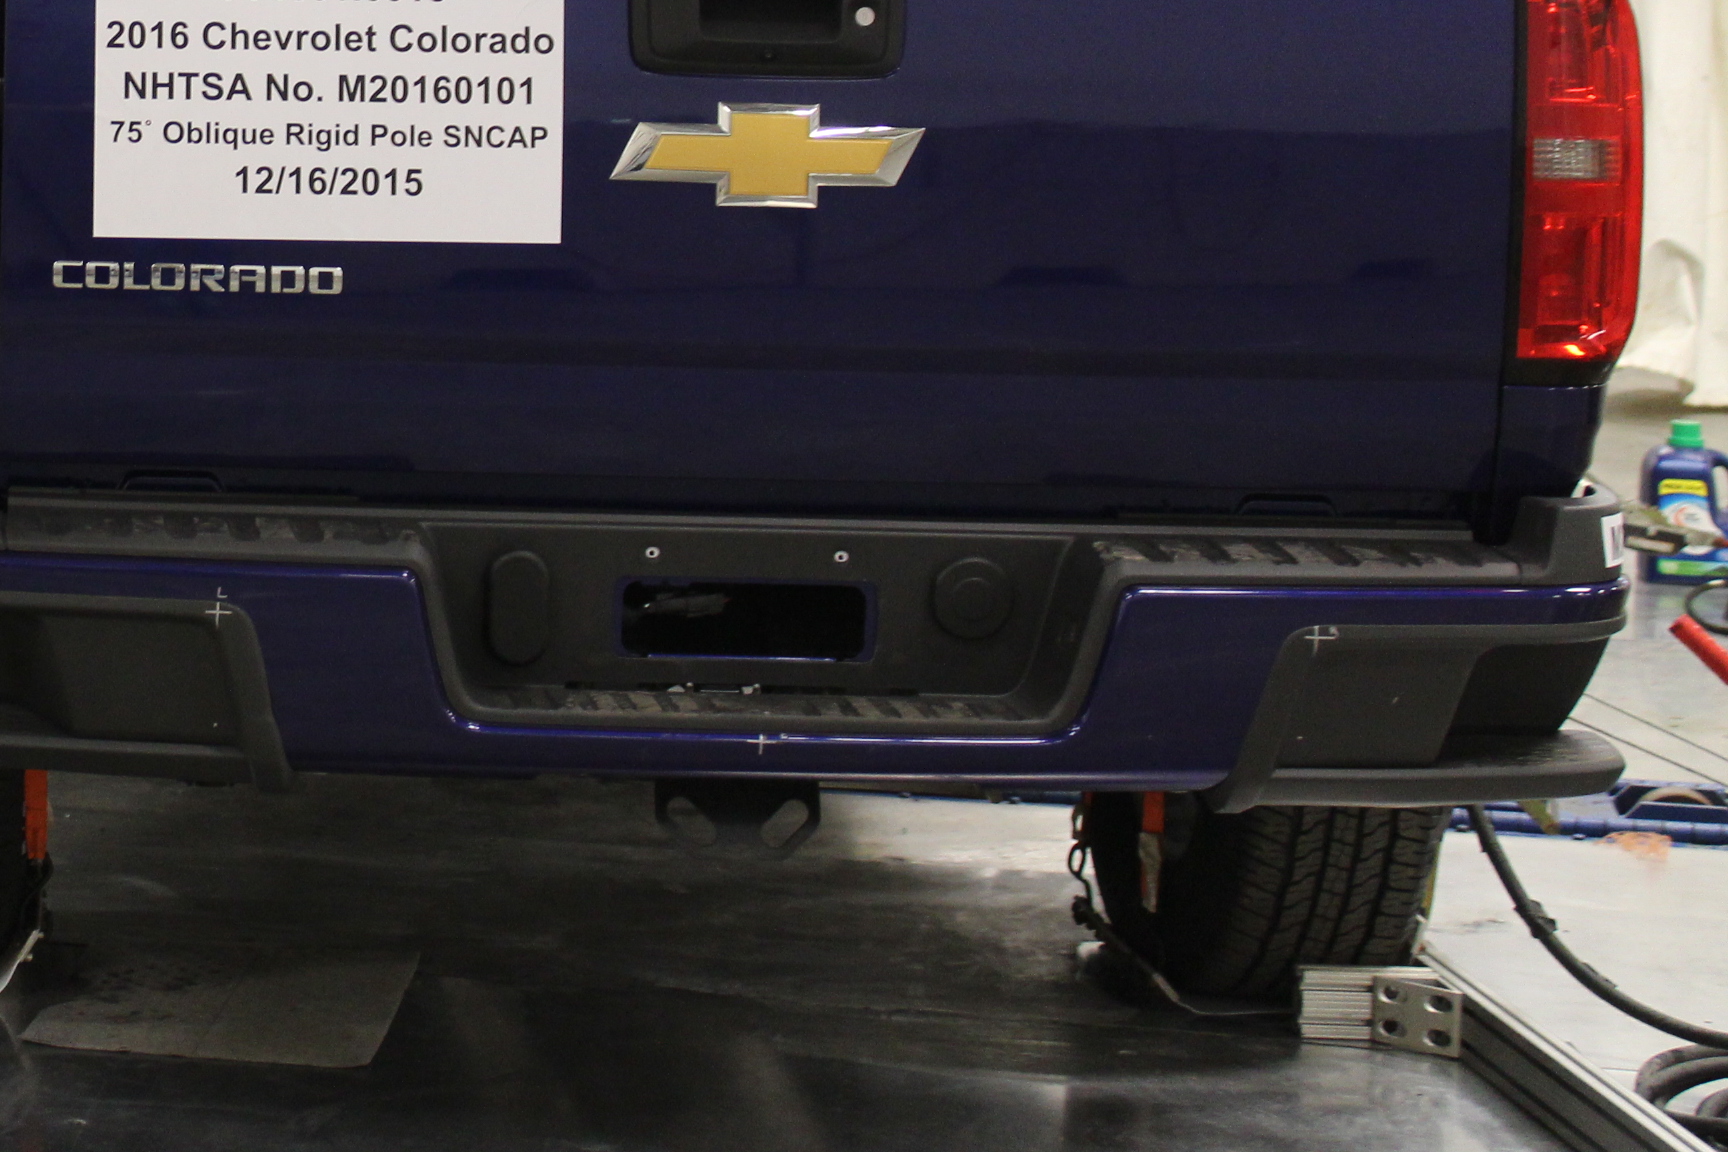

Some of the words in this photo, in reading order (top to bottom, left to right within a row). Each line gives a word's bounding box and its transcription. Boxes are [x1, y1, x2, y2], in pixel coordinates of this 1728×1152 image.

[106, 20, 189, 50] 2016
[202, 21, 377, 53] Chevrolet
[389, 23, 555, 55] Colorado
[124, 71, 253, 101] NHTSA
[266, 73, 323, 102] No.
[338, 74, 532, 105] M20160101
[162, 120, 275, 151] Oblique
[285, 122, 359, 152] Rigid
[370, 123, 433, 148] Pole
[443, 124, 548, 149] SNCAP
[235, 165, 423, 197] 12/16/2015
[52, 259, 344, 295] COLORADO
